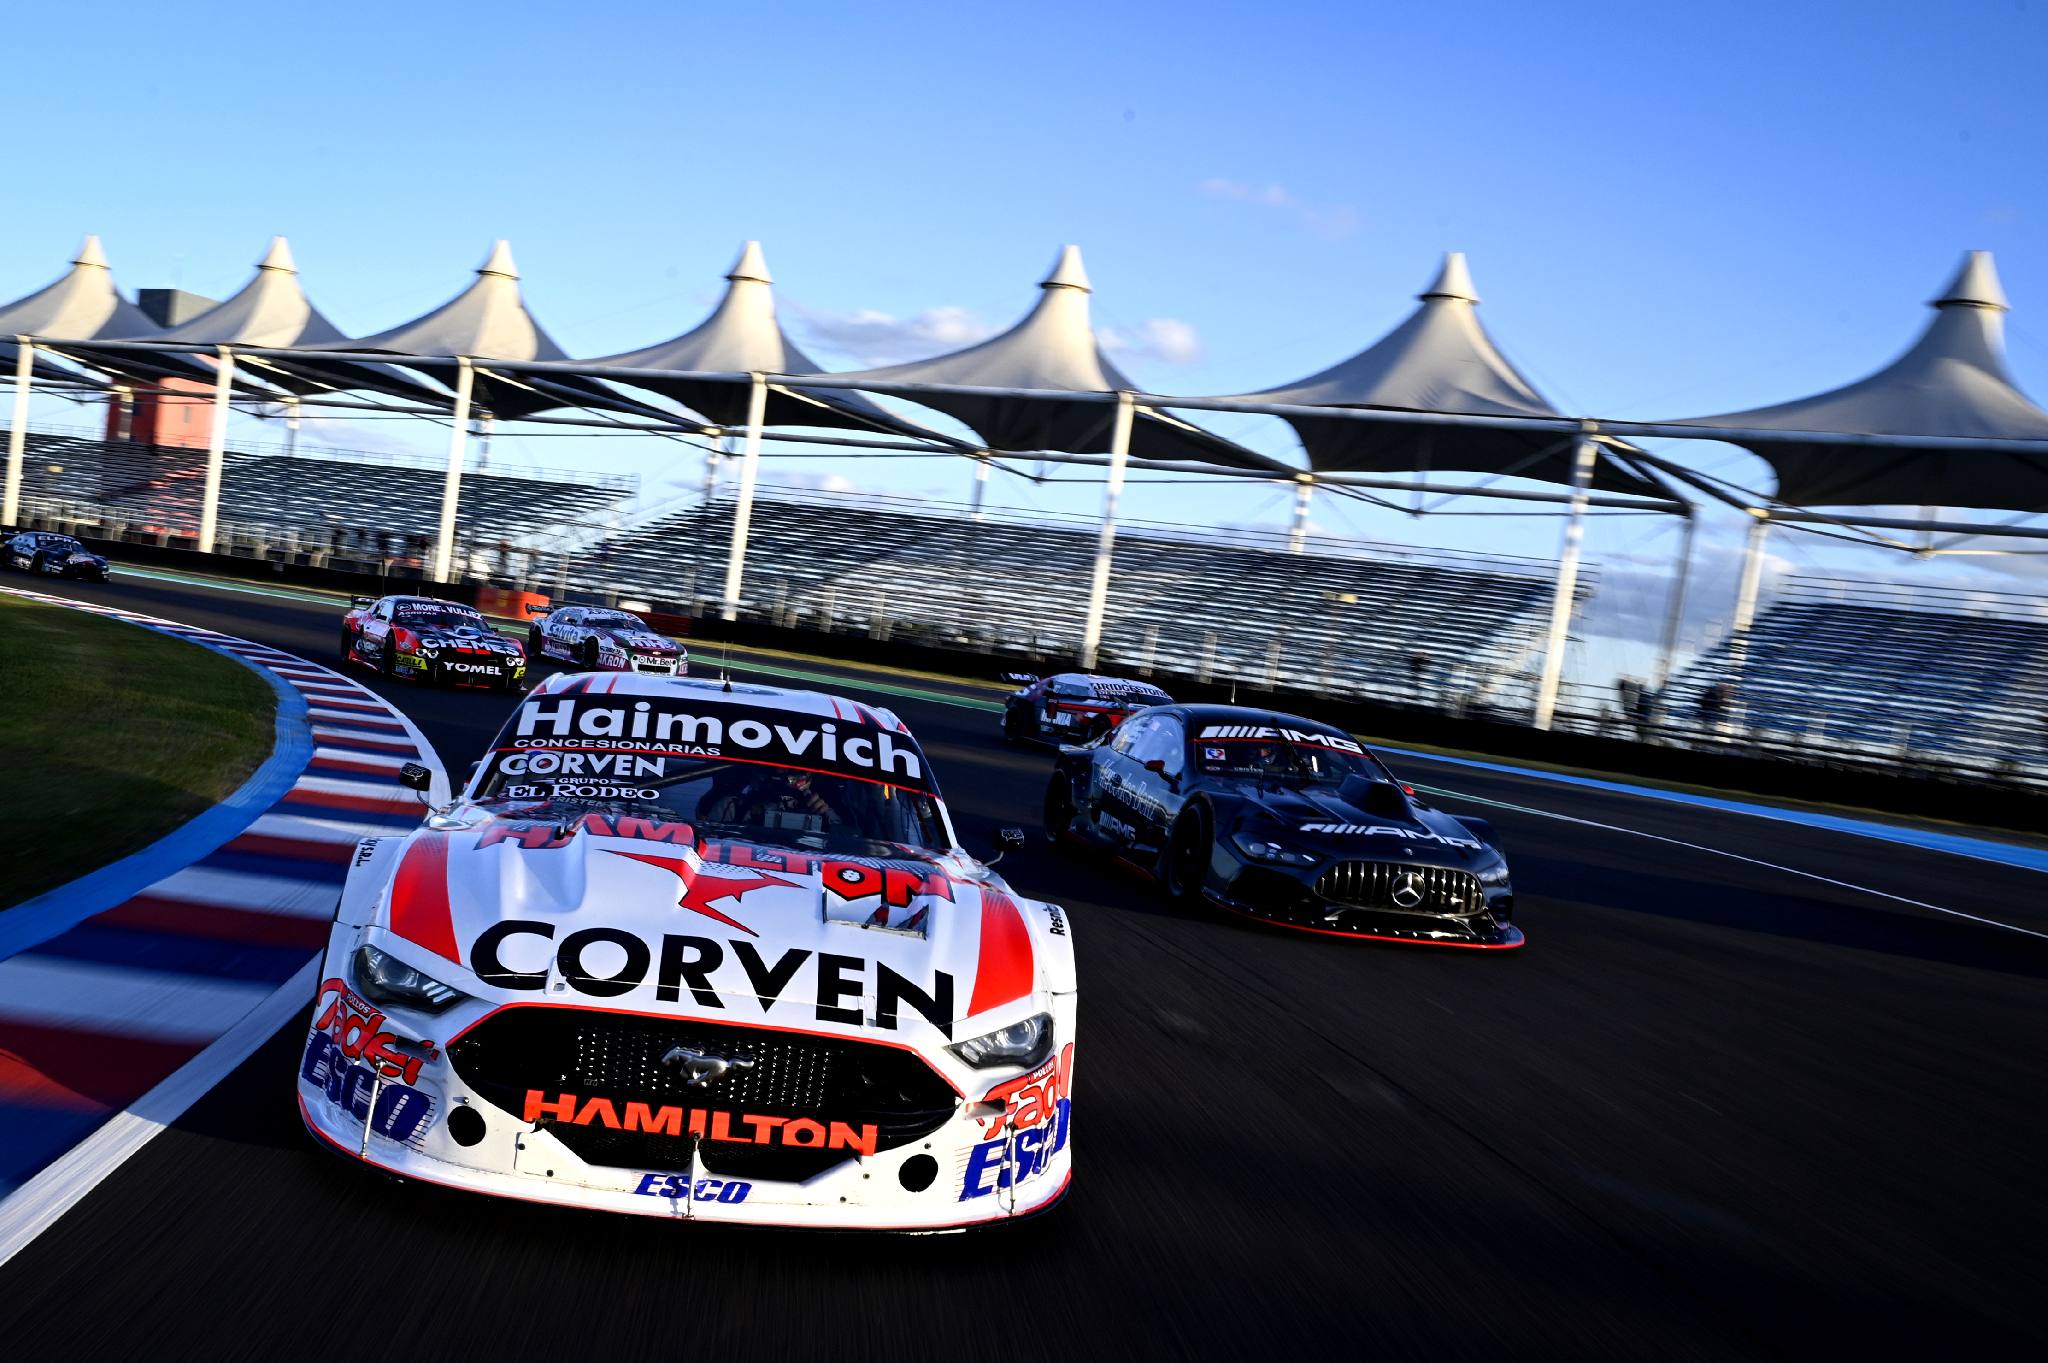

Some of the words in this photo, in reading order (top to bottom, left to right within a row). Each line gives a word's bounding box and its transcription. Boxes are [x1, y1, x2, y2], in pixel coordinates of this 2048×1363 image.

[422, 638, 521, 657] CHEMES
[443, 661, 503, 676] YOMEL
[513, 738, 721, 756] CONCESIONARIAS
[516, 700, 922, 779] Haimovich
[500, 752, 666, 779] CORVEN
[507, 784, 546, 798] EL
[552, 784, 661, 800] RODEO
[558, 777, 611, 785] GRUPO
[469, 918, 955, 1043] CORVEN
[346, 992, 372, 1014] POLLOS
[302, 1030, 433, 1142] ESCO
[522, 1088, 879, 1157] HAMILTON
[633, 1173, 753, 1205] ESCO
